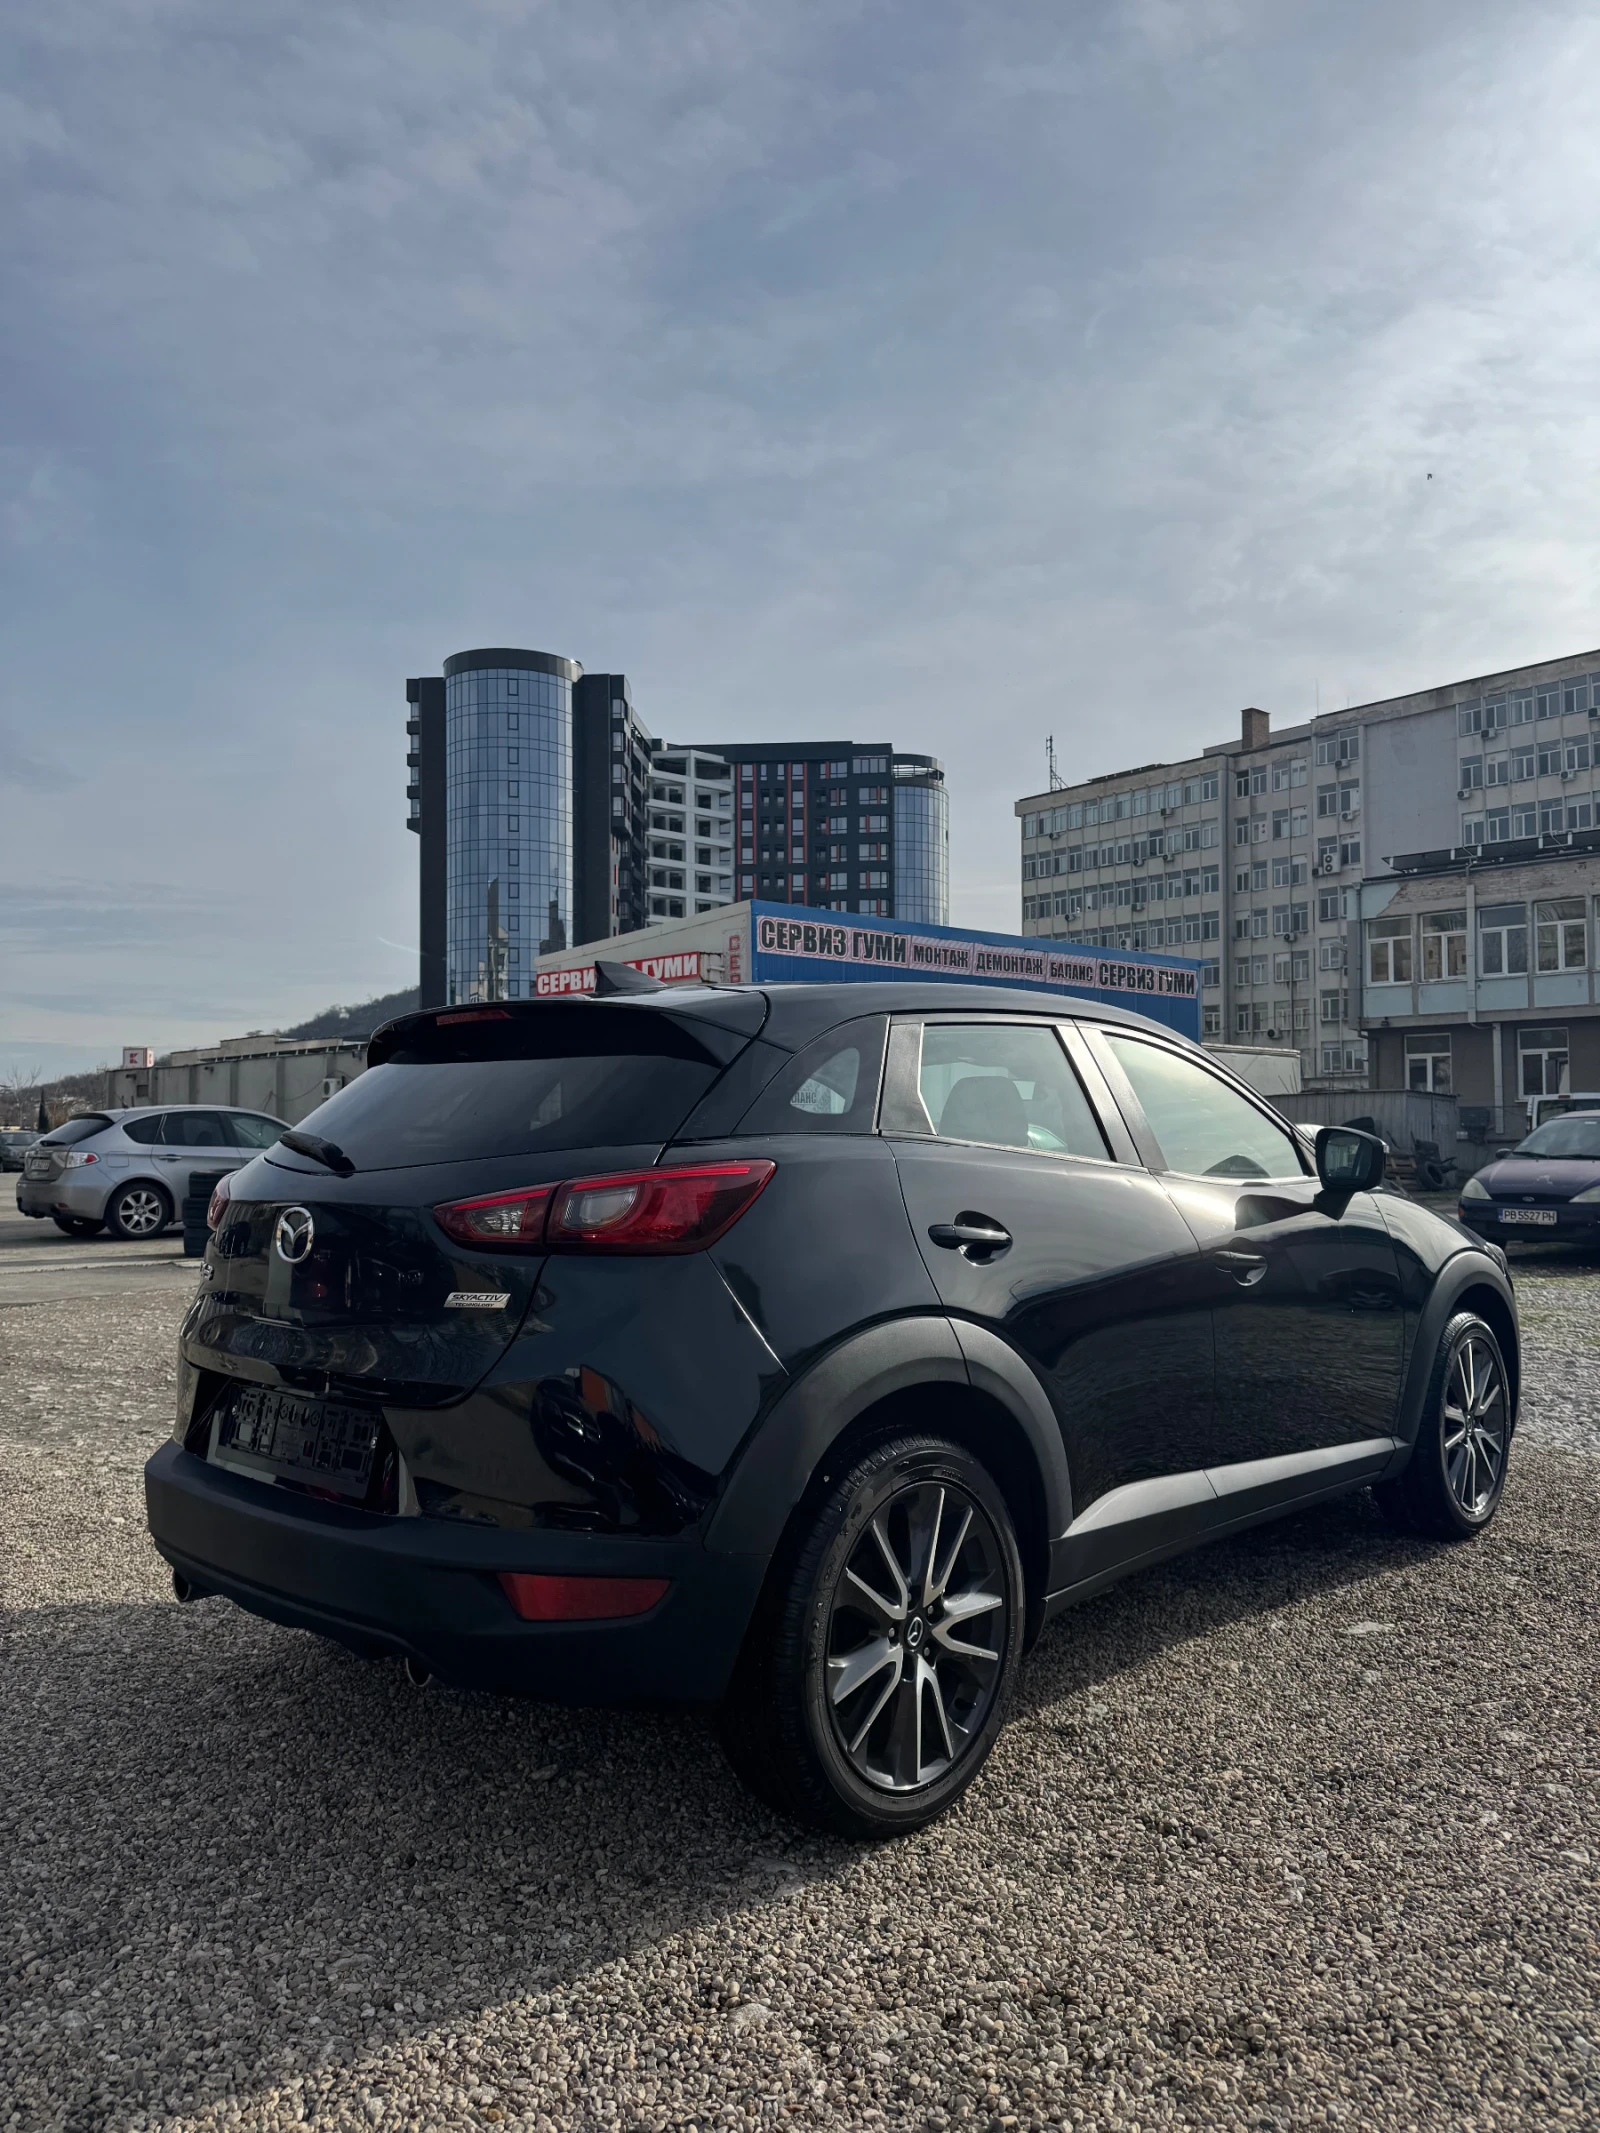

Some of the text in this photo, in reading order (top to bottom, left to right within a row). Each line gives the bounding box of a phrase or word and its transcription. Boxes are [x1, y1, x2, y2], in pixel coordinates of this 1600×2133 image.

[761, 920, 906, 963] СЕРВИЗ ГУМИ
[913, 945, 969, 968] МОНТАЖ
[977, 952, 1043, 975] ДЕМОНТАЖ
[537, 954, 697, 994] СЕРВИ ГУМИ
[1050, 962, 1093, 982] БАЛАНС
[1100, 963, 1195, 995] СЕРВИЗ ГУМИ
[791, 1091, 817, 1104] ЛАНС
[1504, 1210, 1555, 1221] PB 5527 PH
